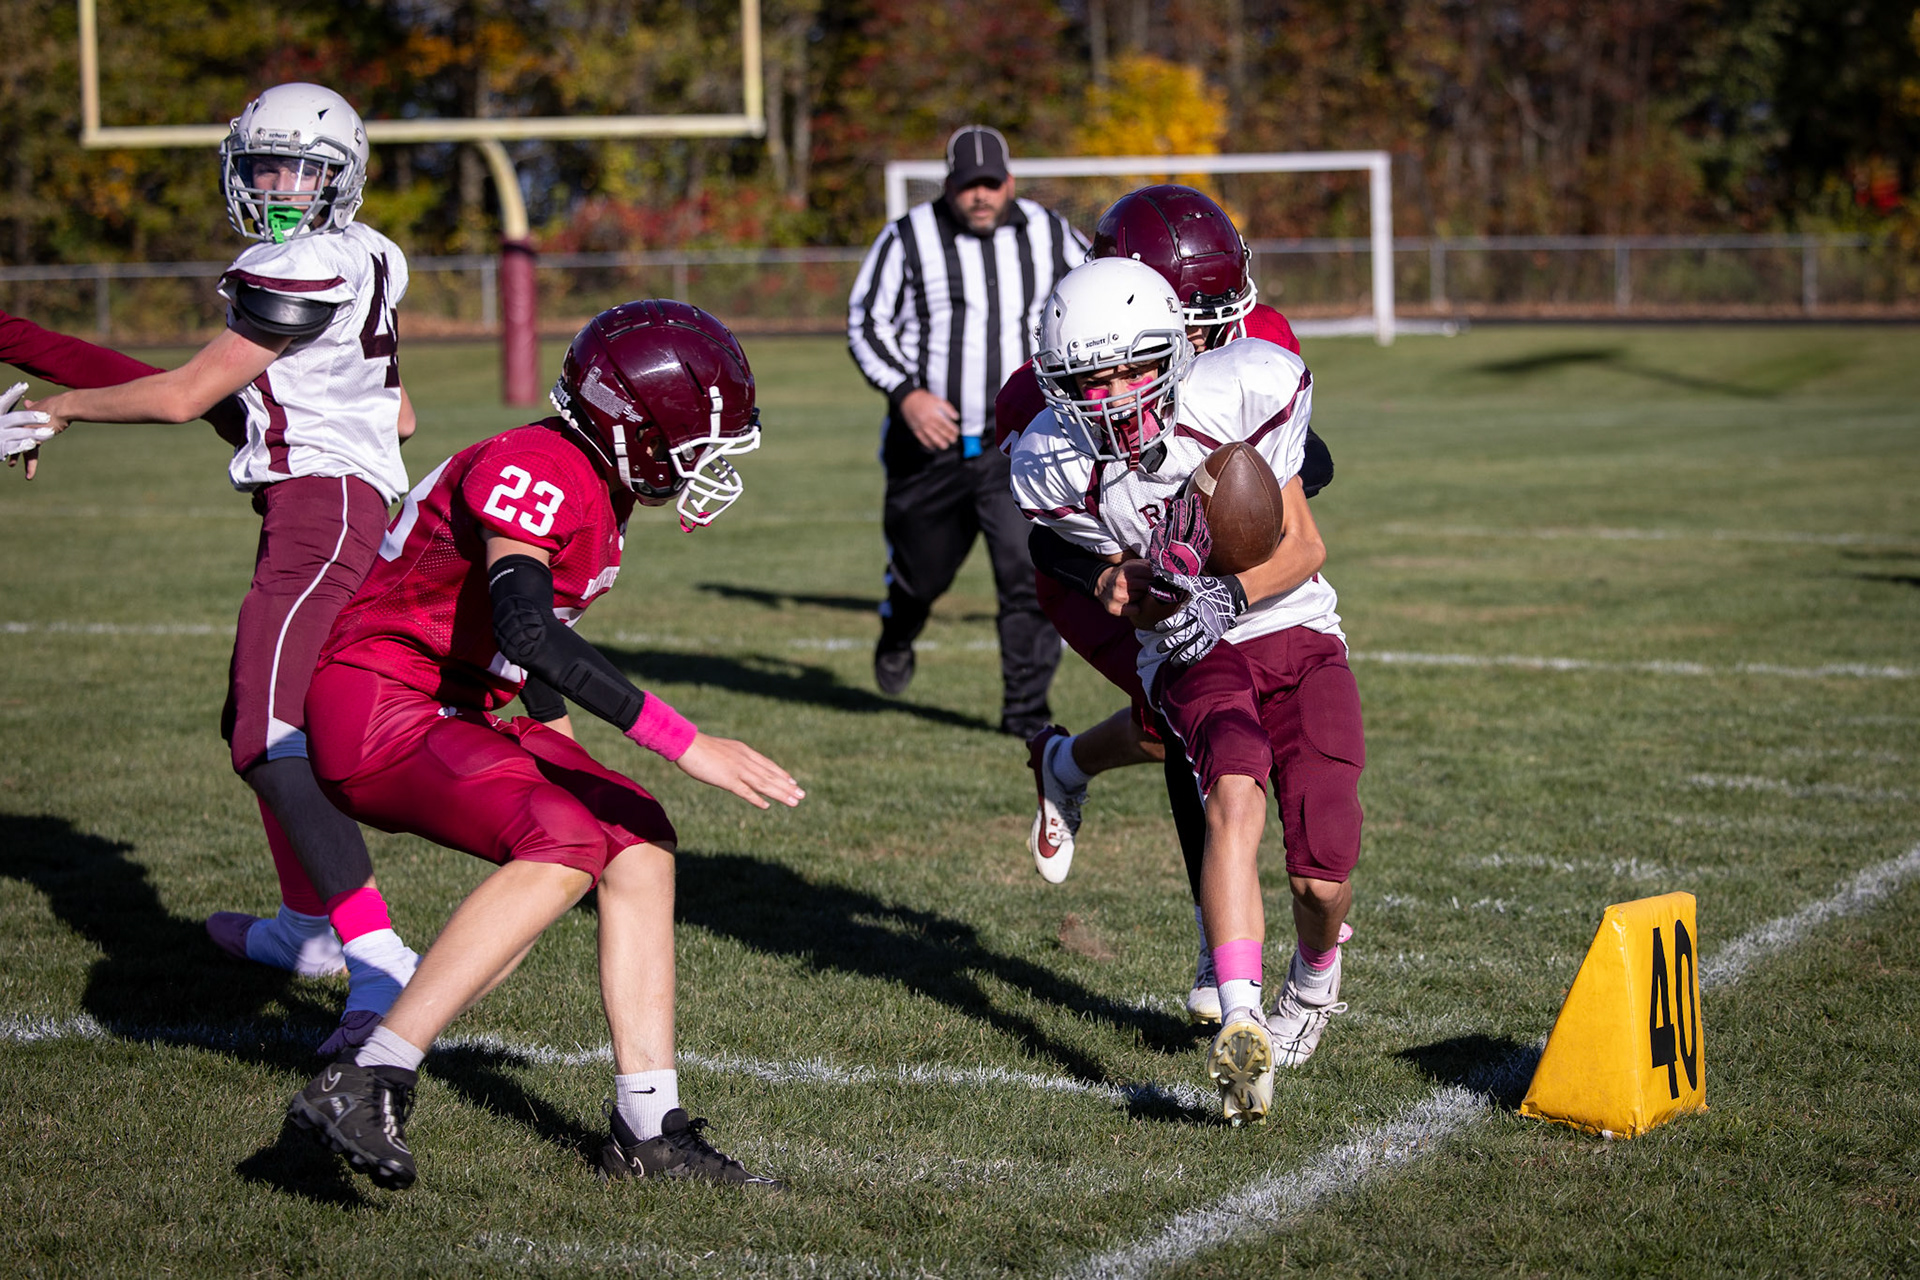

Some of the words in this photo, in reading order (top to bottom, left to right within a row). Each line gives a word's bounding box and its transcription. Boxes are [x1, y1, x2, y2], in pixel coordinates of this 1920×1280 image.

[1085, 338, 1106, 348] schutt
[482, 464, 566, 537] 23
[1650, 918, 1698, 1100] 40
